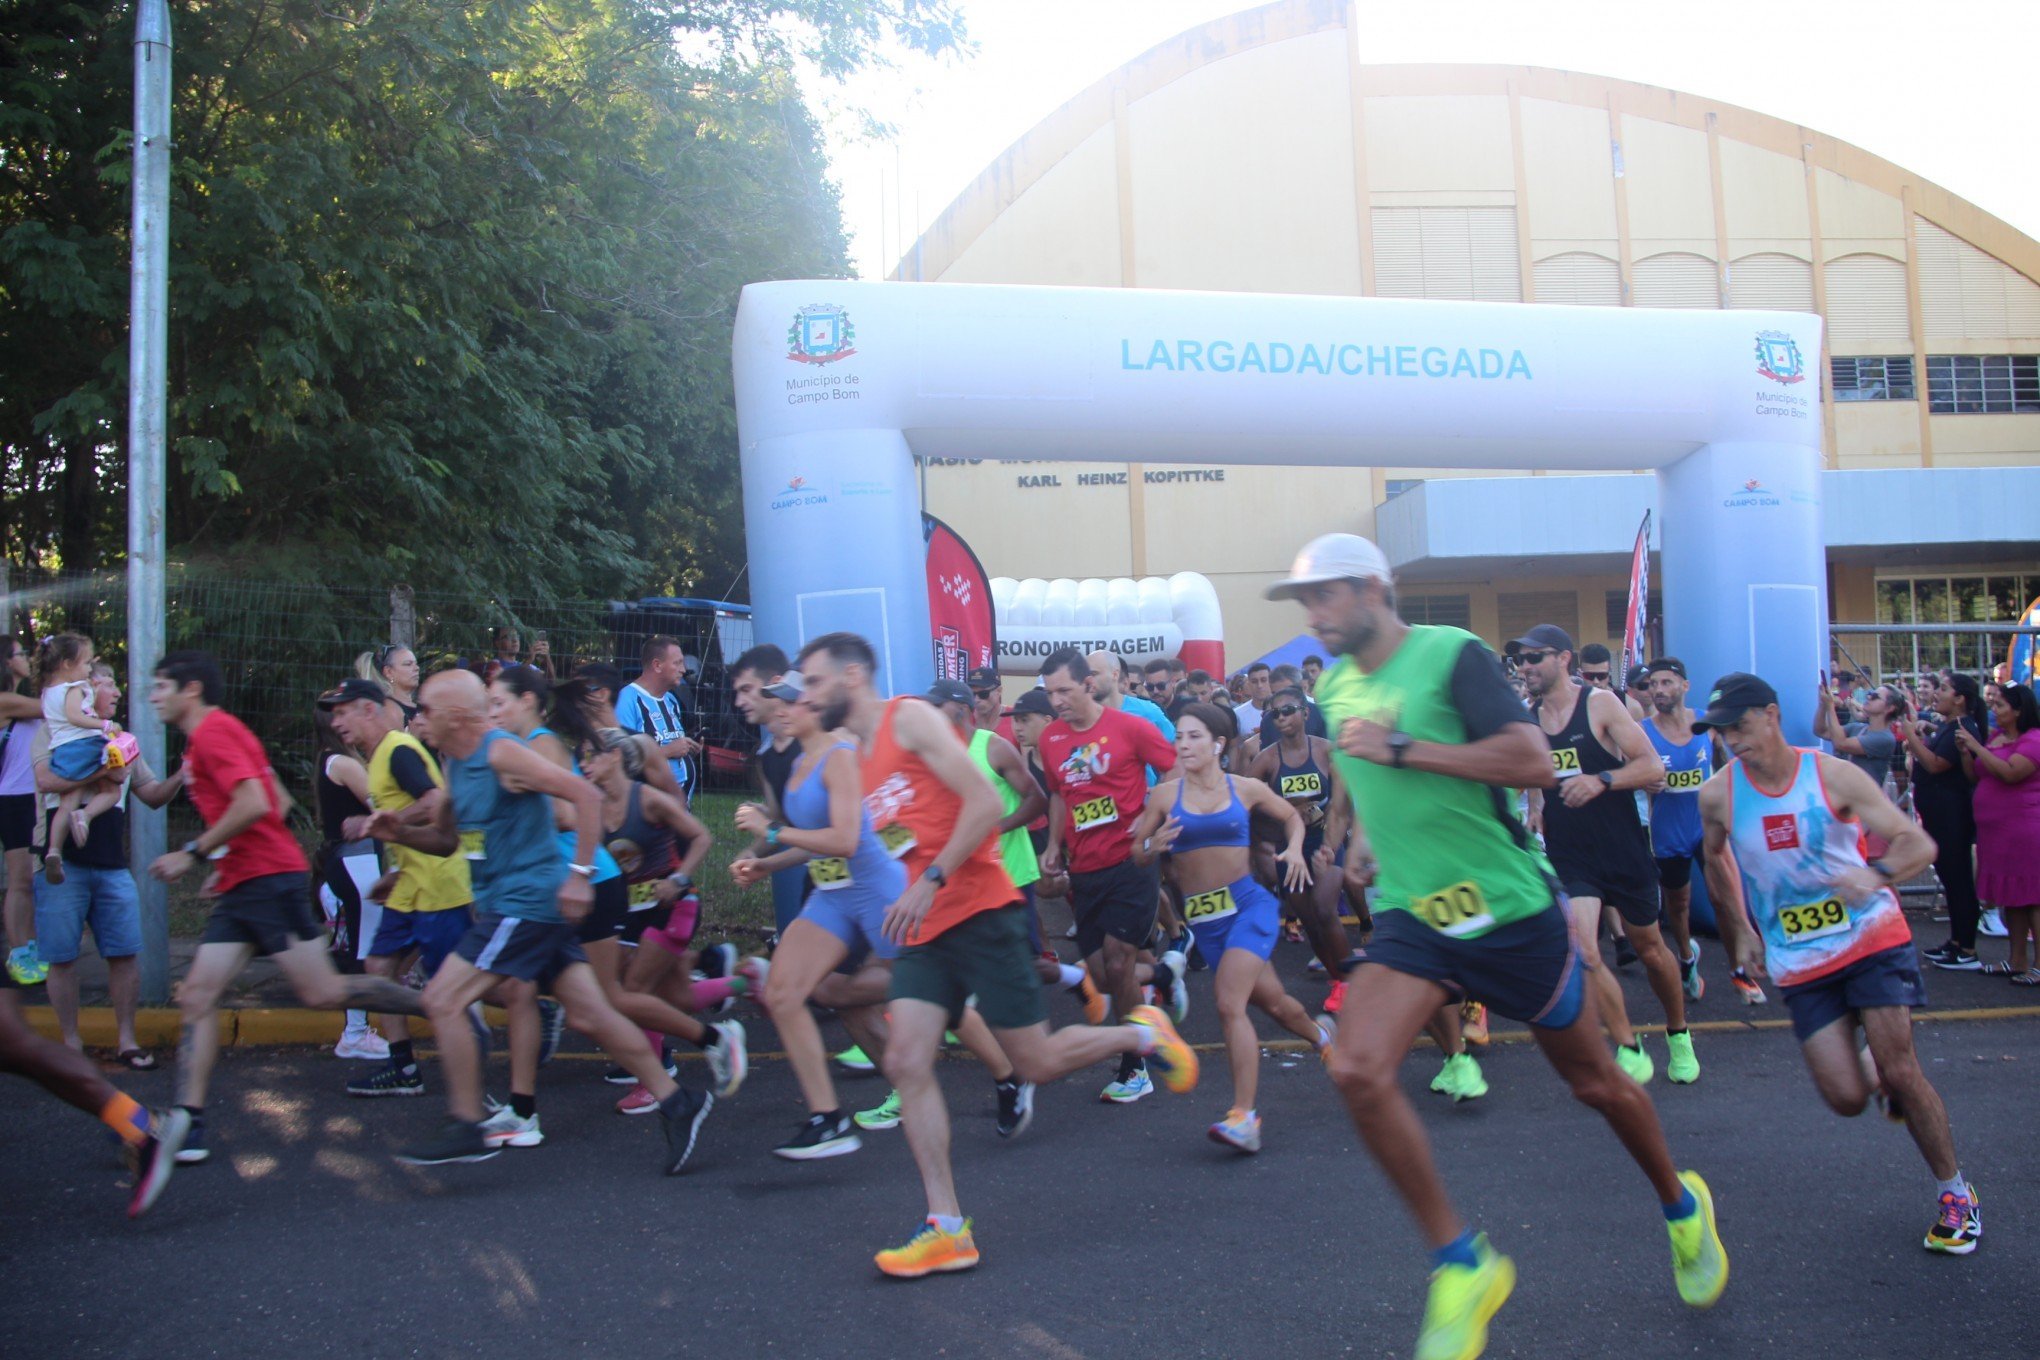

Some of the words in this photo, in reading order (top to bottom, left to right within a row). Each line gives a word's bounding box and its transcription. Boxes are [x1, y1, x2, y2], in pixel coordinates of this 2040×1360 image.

[1121, 339, 1533, 380] LARGADA/CHEGADA
[786, 374, 841, 390] Município
[844, 374, 860, 384] de
[788, 391, 829, 405] Campo
[833, 389, 860, 400] Bom
[1756, 392, 1798, 404] Município
[1756, 404, 1789, 417] Campo
[1791, 407, 1807, 419] Bom
[1017, 475, 1062, 488] KARL
[1078, 472, 1127, 485] HEINZ
[1143, 470, 1225, 484] KOPITTKE
[771, 498, 802, 510] CAMPO
[805, 495, 828, 504] BOM
[1723, 498, 1757, 507] CAMPO
[1760, 498, 1780, 506] BOM
[1284, 775, 1319, 793] 236
[1667, 770, 1701, 787] 095
[1074, 797, 1114, 823] 338
[1189, 890, 1226, 918] 257
[1782, 900, 1844, 934] 339
